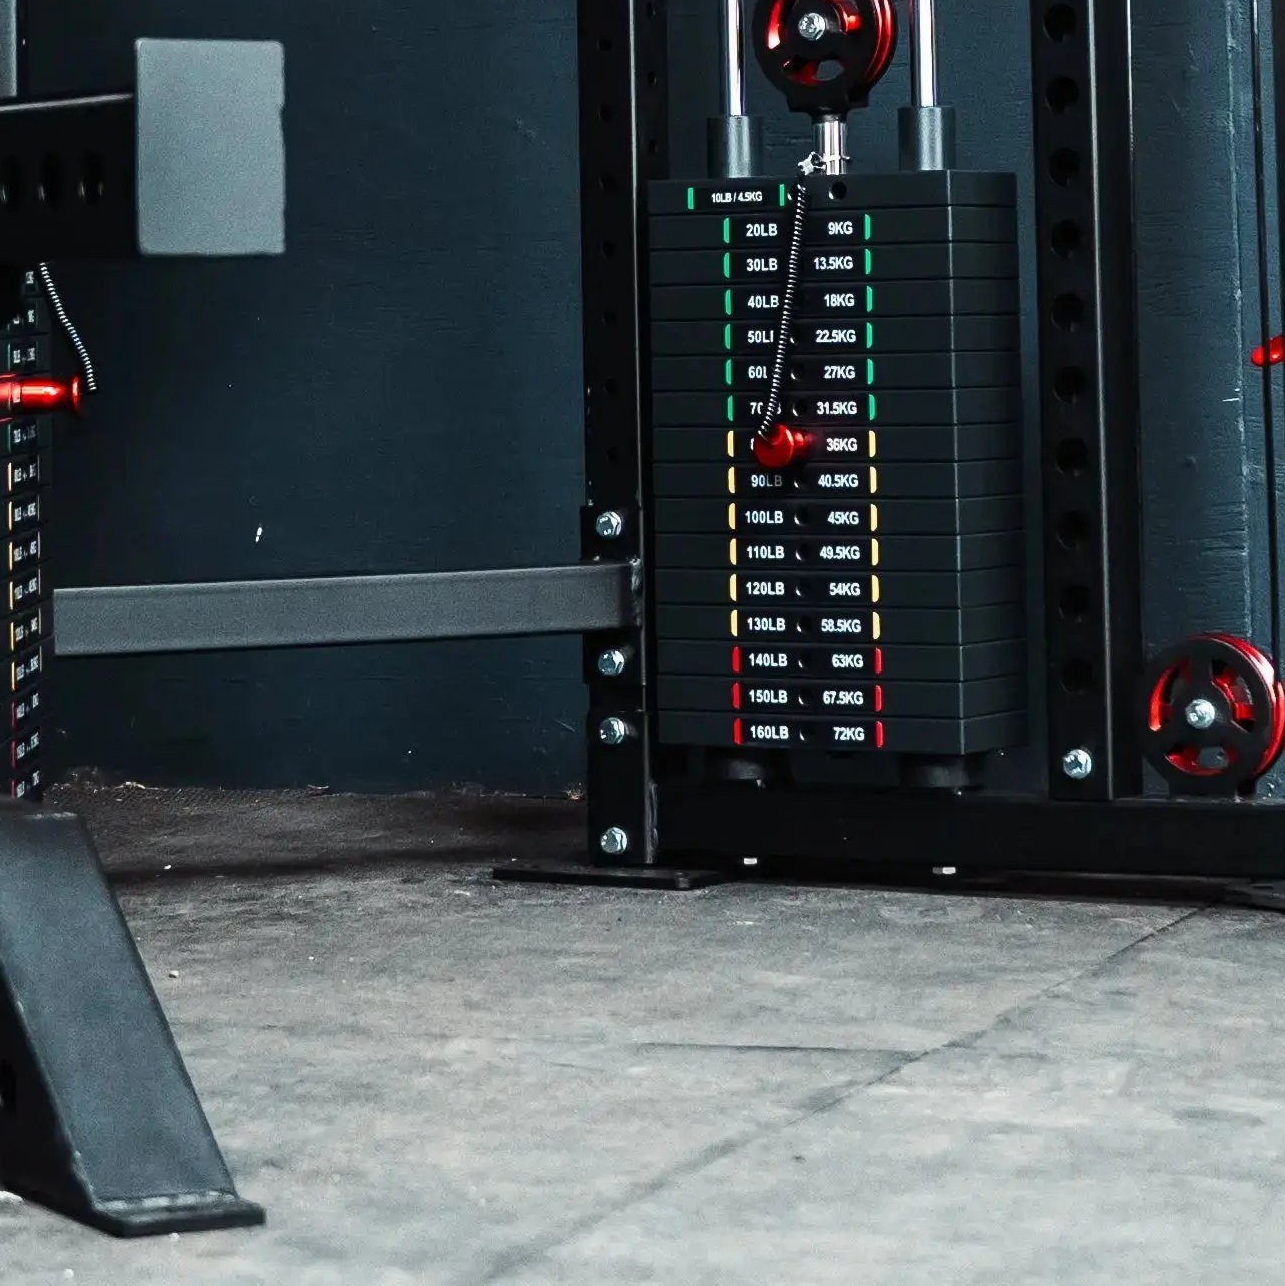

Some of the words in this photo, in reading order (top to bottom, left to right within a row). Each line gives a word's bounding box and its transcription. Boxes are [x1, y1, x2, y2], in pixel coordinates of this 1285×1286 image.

[711, 192, 732, 203] 10LB
[745, 222, 778, 237] 20LB
[827, 220, 854, 236] 9KG
[746, 257, 778, 272] 30LB
[813, 255, 854, 270] 13.5KG
[747, 294, 780, 309] 40LB
[823, 293, 855, 308] 18KG
[815, 329, 857, 343] 22.5KG
[823, 365, 856, 380] 27KG
[816, 400, 858, 415] 31.5KG
[826, 437, 858, 452] 36KG
[750, 474, 783, 488] 90LB
[817, 473, 859, 488] 40.5KG
[744, 510, 784, 524] 100LB
[827, 510, 860, 525] 45KG
[746, 545, 785, 560] 110LB
[819, 545, 861, 560] 49.5KG
[745, 581, 785, 596] 120LB
[829, 582, 861, 597] 54KG
[746, 616, 786, 632] 130LB
[820, 618, 862, 634] 58.5KG
[748, 652, 788, 667] 140LB
[831, 653, 864, 668] 63KG
[748, 689, 788, 704] 150LB
[822, 690, 864, 706] 67.5KG
[750, 724, 790, 740] 160LB
[832, 726, 865, 742] 72KG
